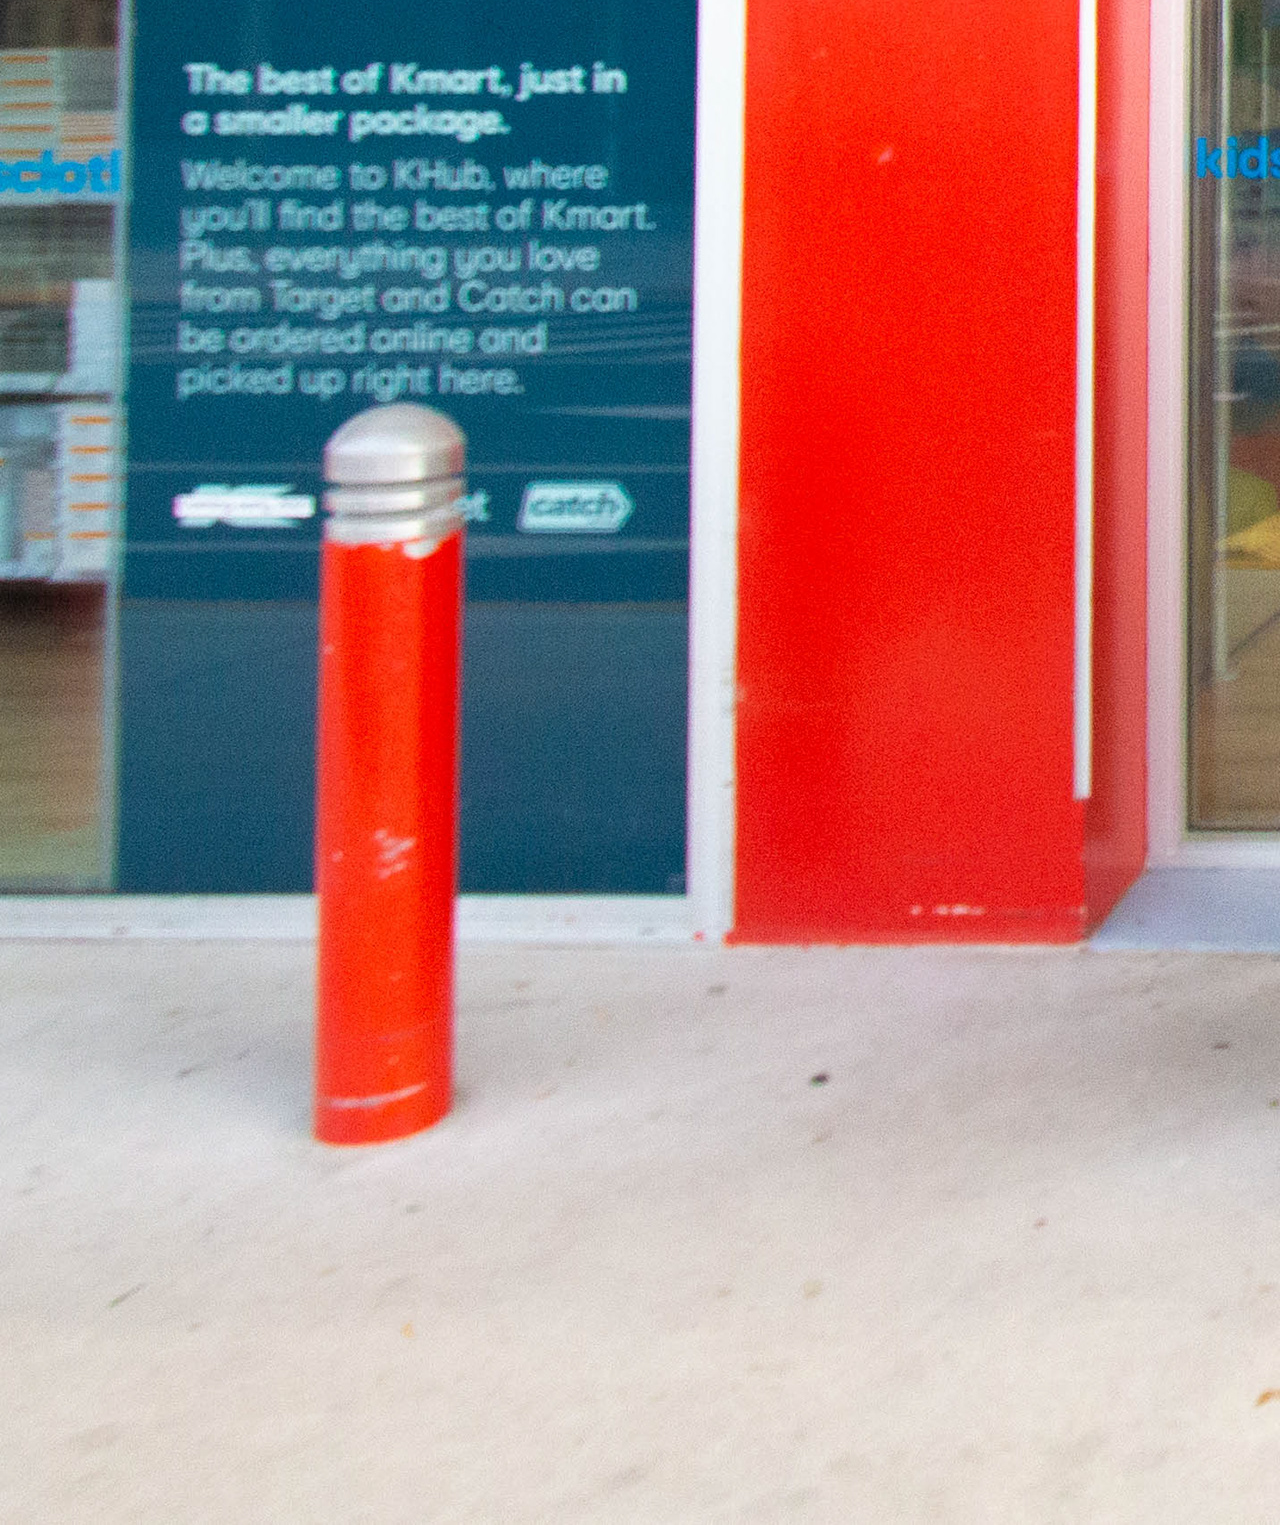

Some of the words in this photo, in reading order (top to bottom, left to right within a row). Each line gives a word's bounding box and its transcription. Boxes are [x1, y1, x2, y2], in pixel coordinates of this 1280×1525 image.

[183, 62, 251, 95] The
[255, 61, 337, 95] best
[340, 62, 385, 95] of
[389, 62, 513, 98] Kmart,
[515, 61, 587, 102] just
[592, 61, 628, 94] in
[181, 110, 211, 136] a
[214, 103, 345, 136] smaller
[349, 102, 512, 143] package.
[181, 158, 342, 191] Welcome
[348, 162, 388, 191] to
[503, 158, 610, 190] where
[180, 199, 272, 238] you'll
[278, 199, 345, 232] find
[351, 199, 411, 231] the
[414, 199, 491, 231] best
[495, 198, 536, 231] of
[541, 198, 657, 231] Kmart.
[265, 240, 448, 279] everything
[453, 246, 522, 279] you
[526, 239, 601, 272] love
[180, 280, 263, 312] from
[269, 280, 377, 320] Target
[381, 280, 450, 313] and
[457, 280, 565, 313] Catch
[570, 287, 638, 313] can
[177, 321, 226, 354] be
[229, 321, 367, 354] ordered
[369, 321, 475, 354] online
[478, 321, 549, 354] and
[176, 362, 294, 401] picked
[298, 368, 347, 401] up
[352, 362, 432, 402] right
[438, 362, 526, 395] here.
[531, 489, 616, 519] catch
